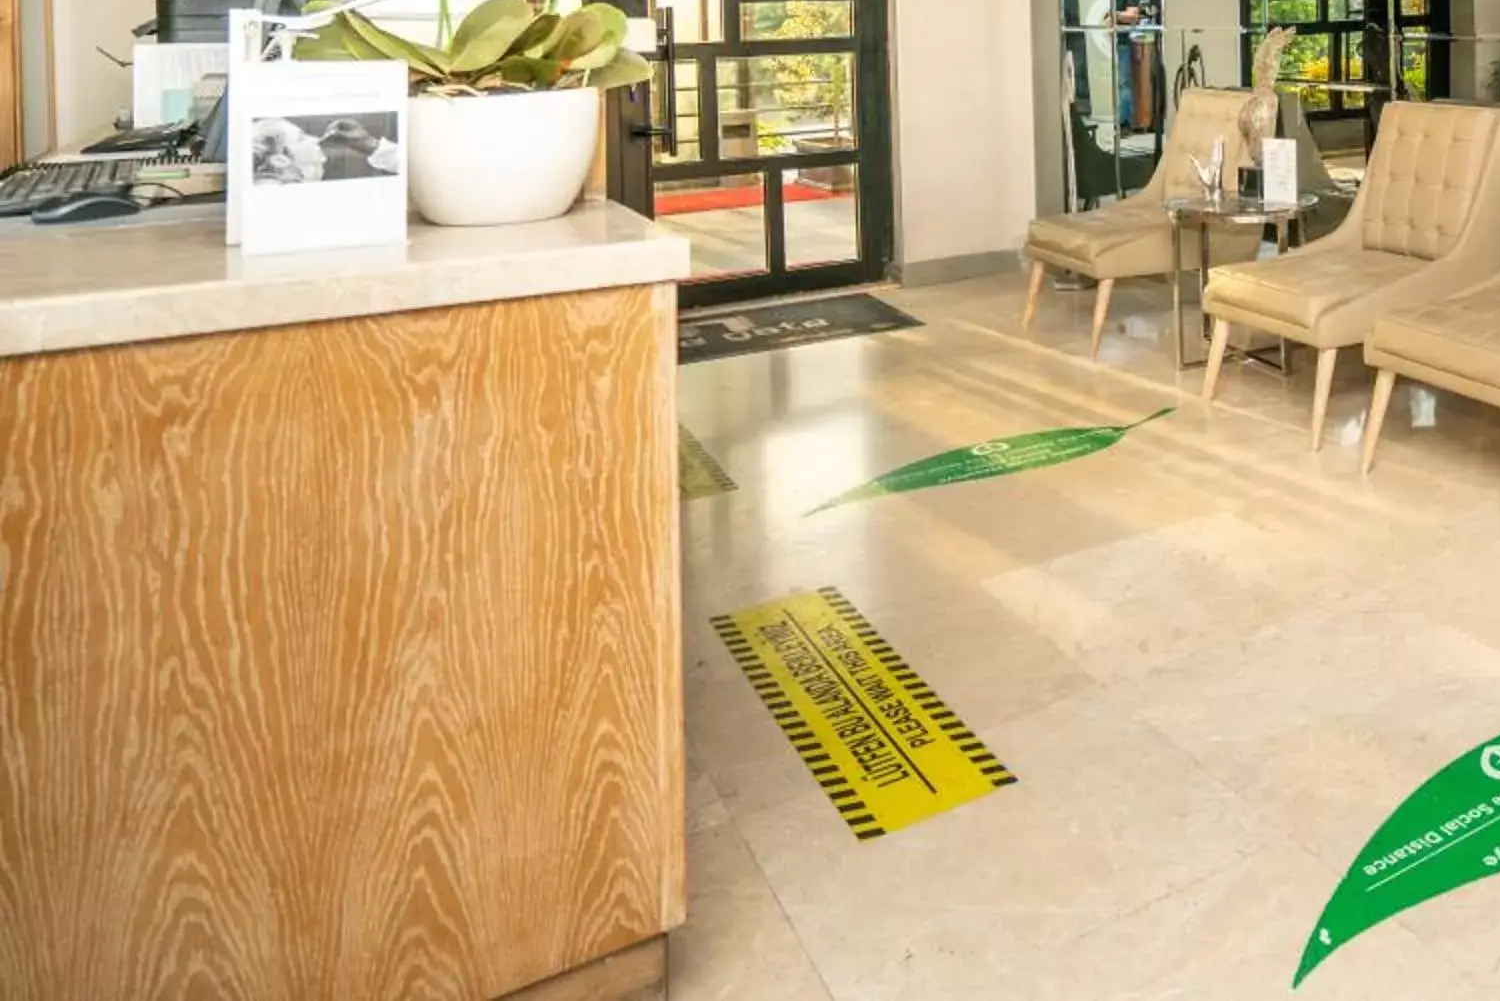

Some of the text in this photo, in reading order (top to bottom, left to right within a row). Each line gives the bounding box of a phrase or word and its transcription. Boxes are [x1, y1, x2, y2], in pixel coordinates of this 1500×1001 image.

[799, 673, 855, 719] ALANDA
[815, 624, 936, 749] PLEASE WAIT THIS AREA
[831, 715, 872, 739] BU
[1439, 802, 1495, 835] Social
[1362, 831, 1443, 876] Distance
